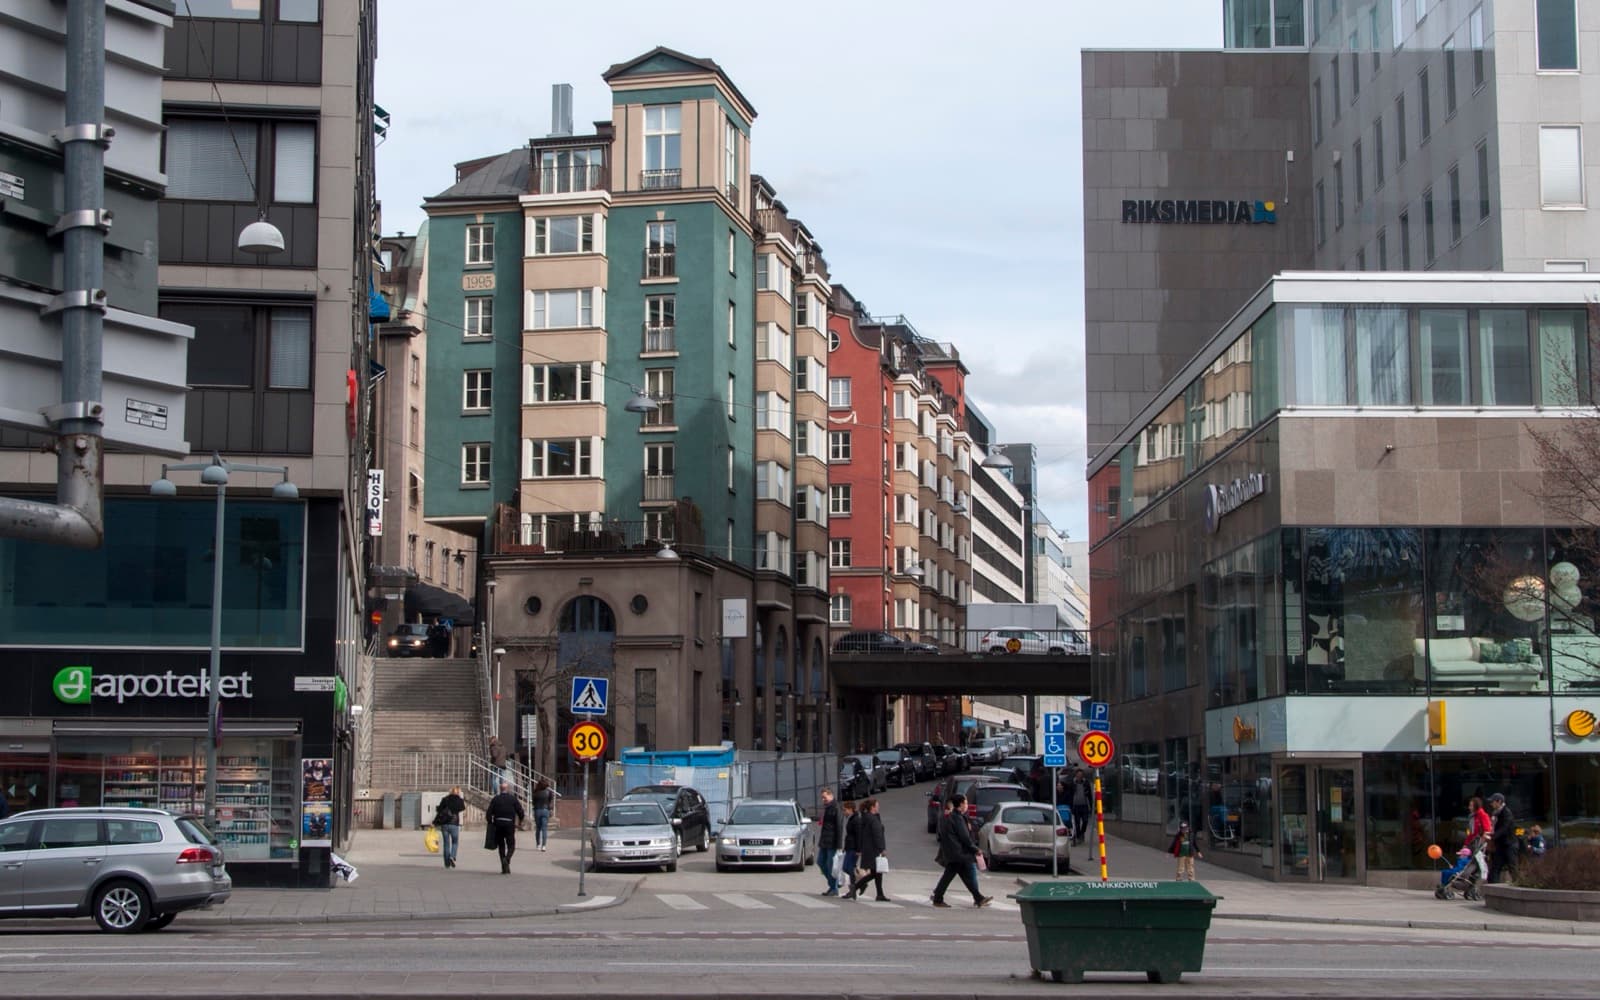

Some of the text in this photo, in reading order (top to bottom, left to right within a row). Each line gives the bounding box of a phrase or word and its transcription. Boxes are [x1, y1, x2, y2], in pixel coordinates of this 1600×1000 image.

[1121, 200, 1251, 223] RIKSMEDIA
[465, 275, 493, 288] 1995
[99, 668, 252, 703] apoteket
[1095, 705, 1106, 719] P
[1049, 715, 1061, 732] P
[575, 732, 602, 751] 30
[1086, 740, 1109, 758] 30
[1086, 881, 1159, 889] TRAFIKKONTORET
